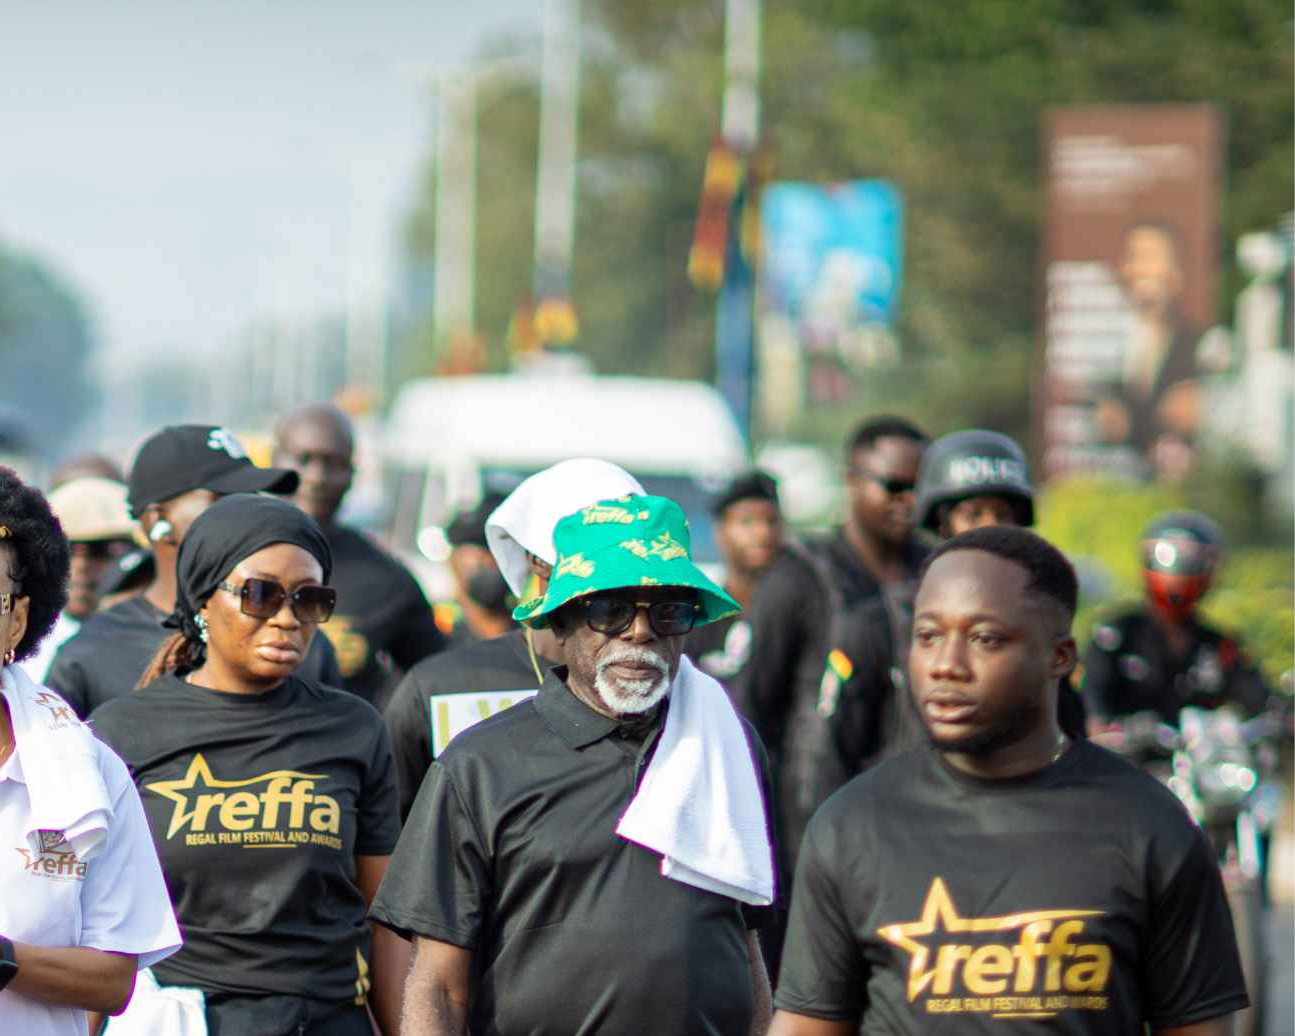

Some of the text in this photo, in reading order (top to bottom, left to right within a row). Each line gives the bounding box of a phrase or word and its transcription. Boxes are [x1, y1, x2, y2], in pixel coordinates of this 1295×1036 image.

[190, 777, 341, 834] reffa
[186, 834, 216, 846] REGAL
[218, 832, 241, 844] FILM
[243, 831, 286, 844] FESTIVAL
[288, 831, 309, 843] AND
[931, 919, 1113, 995] reffa
